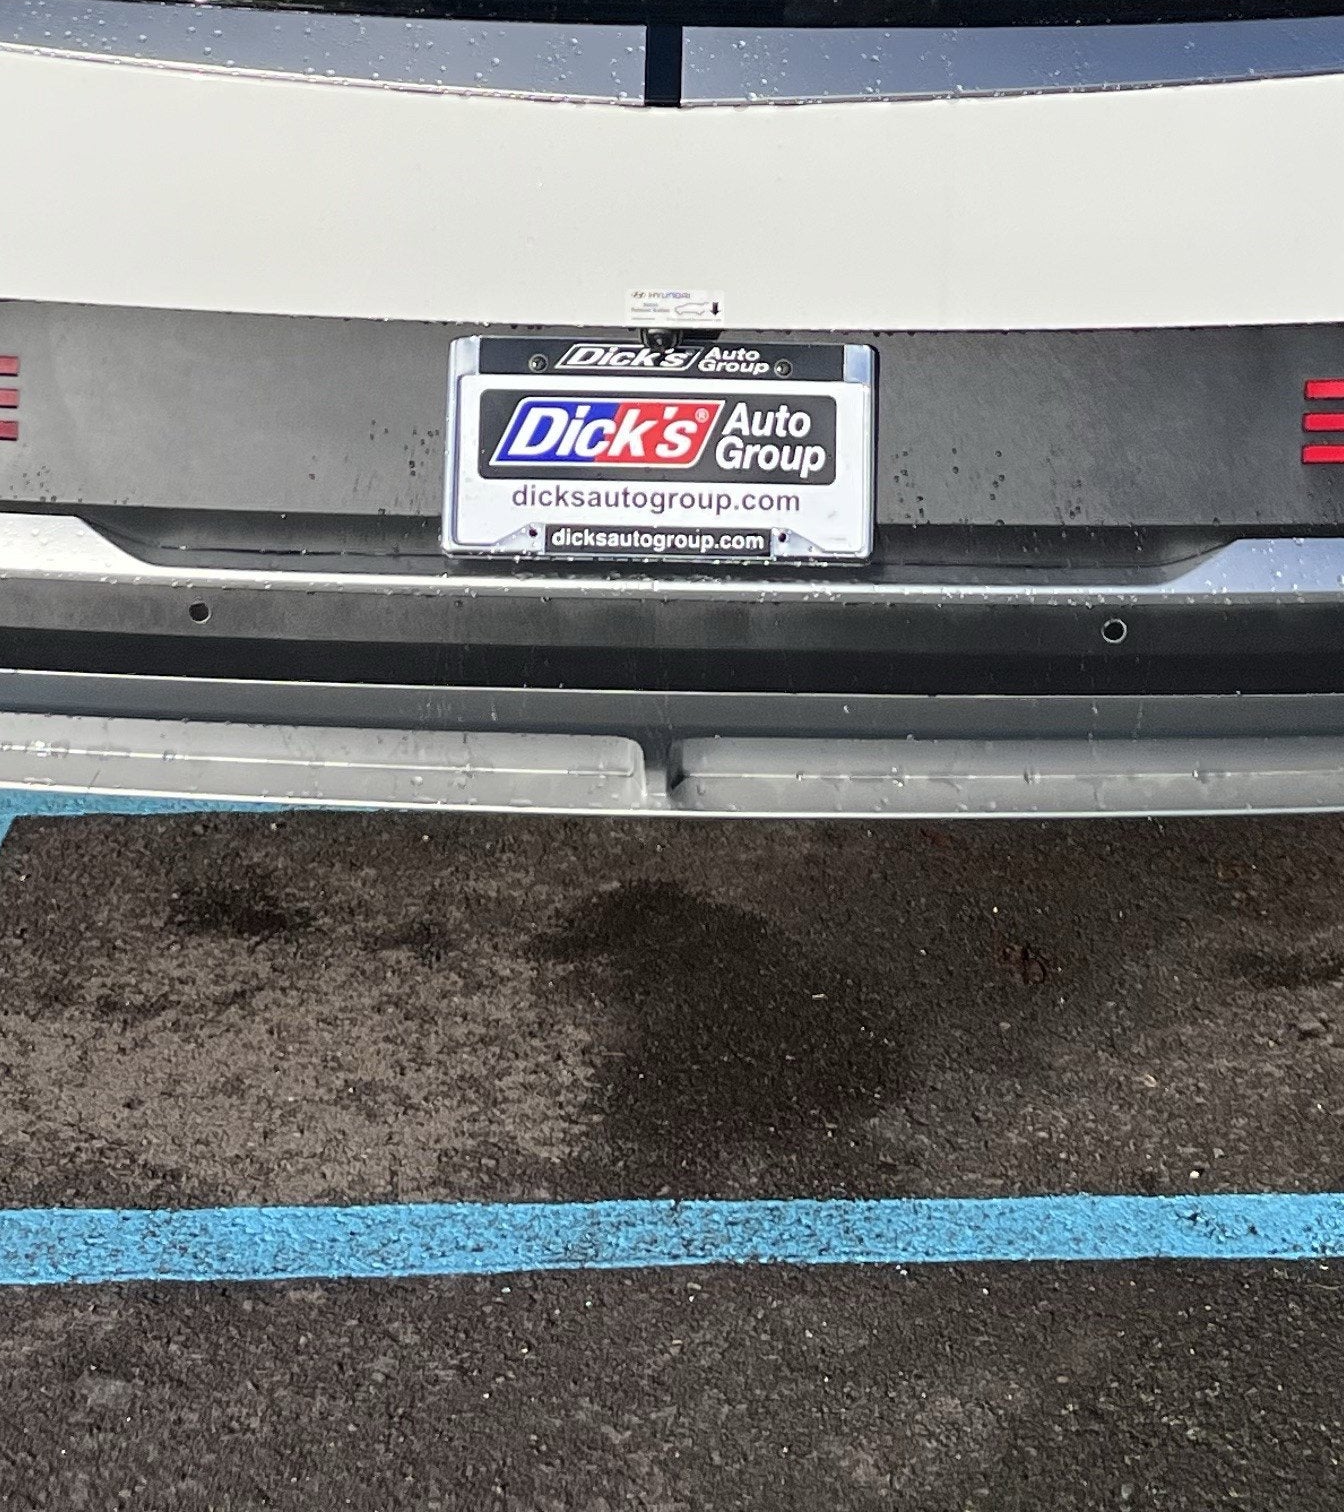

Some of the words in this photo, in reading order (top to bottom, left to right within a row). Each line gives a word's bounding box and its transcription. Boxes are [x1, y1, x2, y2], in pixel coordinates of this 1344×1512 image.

[567, 346, 687, 367] Dick's
[698, 359, 769, 375] Group
[705, 346, 761, 361] Auto
[507, 405, 697, 458] Dick's
[722, 402, 811, 438] Auto
[716, 437, 826, 479] Group
[512, 485, 800, 514] dicksautogroup.com
[552, 526, 765, 553] dicksautogroup.com
